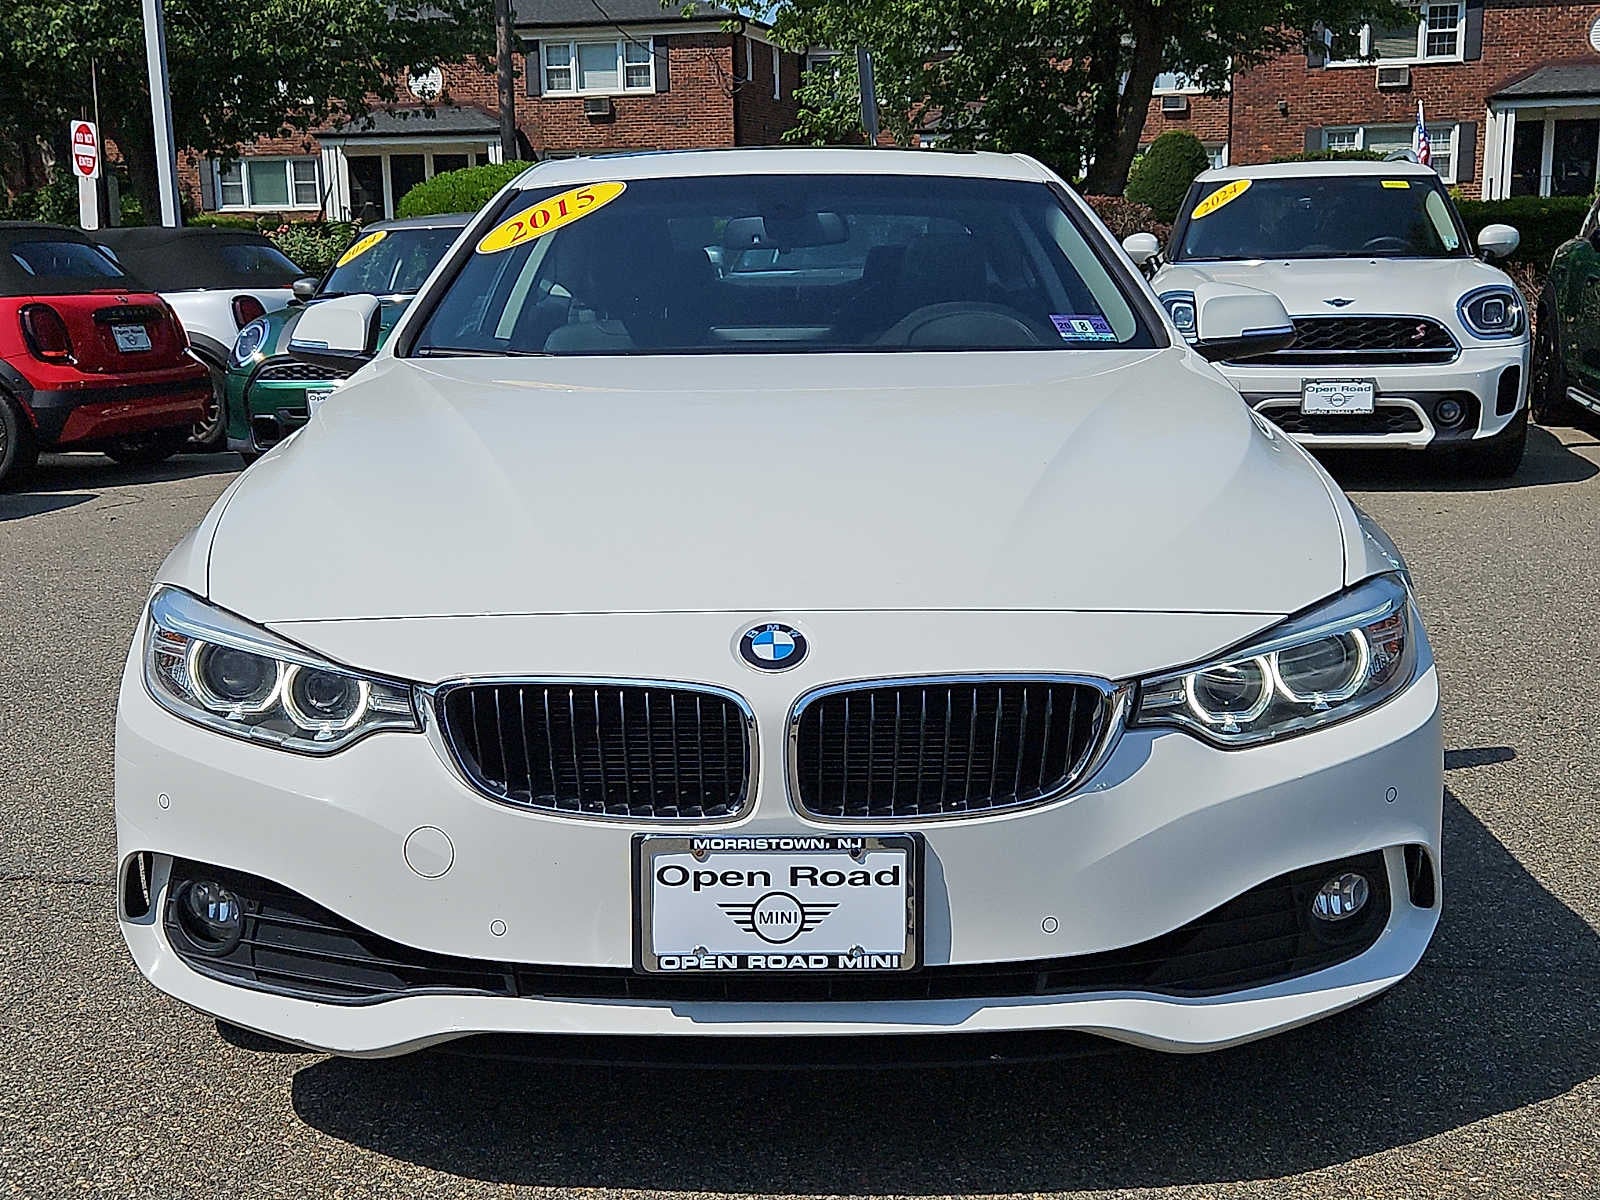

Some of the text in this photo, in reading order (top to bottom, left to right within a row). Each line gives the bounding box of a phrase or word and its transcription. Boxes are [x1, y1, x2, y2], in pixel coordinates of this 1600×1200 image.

[1201, 184, 1237, 213] 2024
[505, 188, 595, 243] 2015
[1079, 321, 1088, 331] 8
[1305, 385, 1337, 393] Open
[746, 624, 801, 638] BMW
[693, 838, 862, 850] MORRISTOWN, NJ
[656, 865, 900, 891] Open Road
[759, 911, 798, 925] MINI
[660, 955, 899, 970] OPEN ROAD MINI
